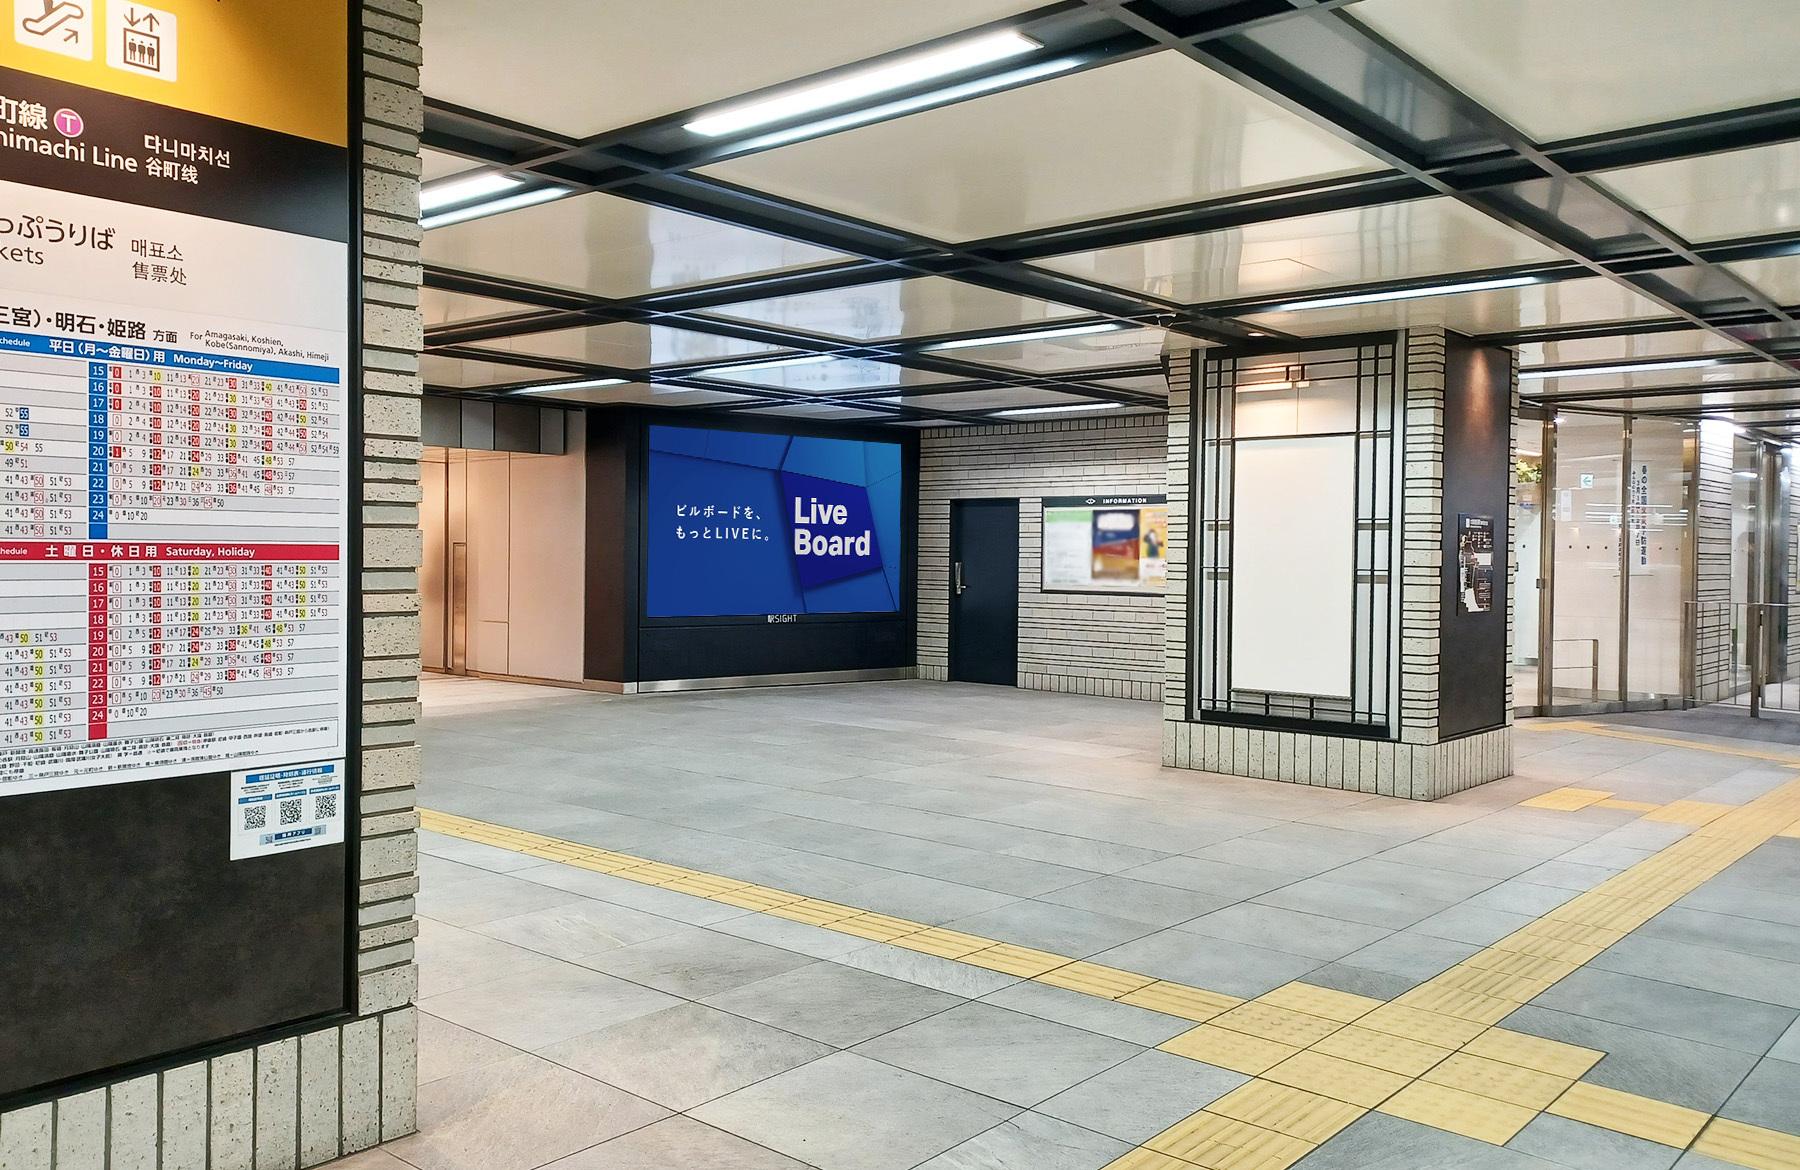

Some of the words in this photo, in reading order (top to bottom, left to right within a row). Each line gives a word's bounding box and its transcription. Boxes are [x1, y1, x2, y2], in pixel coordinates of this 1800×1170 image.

[60, 113, 76, 132] T
[144, 134, 231, 169] 다니마치선
[93, 146, 138, 172] Line
[145, 157, 199, 184] 谷町线
[131, 239, 184, 262] 매표소
[132, 261, 187, 286] 售票处
[153, 330, 178, 344] 方面
[190, 332, 202, 340] For
[204, 330, 250, 344] Amagasaki,
[252, 335, 284, 347] Koshien,
[205, 339, 277, 356] Kobe(Sannomiya),
[278, 348, 305, 358] Akashi,
[306, 352, 330, 362] Himeji
[93, 366, 104, 375] 15
[93, 382, 104, 391] 16
[93, 398, 104, 408] 17
[5, 408, 13, 417] 52
[20, 409, 28, 418] 55
[93, 415, 104, 424] 18
[5, 424, 13, 434] 52
[20, 426, 28, 435] 55
[93, 431, 104, 440] 19
[5, 441, 14, 451] 50
[20, 442, 28, 452] 54
[35, 443, 43, 452] 55
[92, 446, 104, 455] 20
[5, 458, 13, 468] 49
[20, 459, 28, 468] 51
[92, 462, 104, 472] 21
[5, 475, 13, 484] 41
[20, 476, 28, 485] 43
[35, 476, 43, 485] 50
[50, 477, 57, 486] 51
[64, 478, 72, 486] 53
[92, 478, 104, 488] 22
[5, 492, 13, 502] 41
[20, 492, 28, 502] 43
[35, 493, 43, 502] 50
[50, 493, 57, 502] 51
[64, 494, 72, 503] 53
[92, 495, 104, 504] 23
[5, 508, 13, 518] 41
[20, 509, 28, 518] 43
[35, 510, 43, 518] 50
[50, 510, 57, 519] 51
[64, 510, 72, 519] 53
[92, 510, 104, 520] 24
[676, 504, 761, 520] ビルボードを、
[794, 496, 848, 524] Live
[5, 525, 13, 535] 41
[20, 526, 28, 535] 43
[35, 526, 43, 535] 50
[50, 526, 57, 535] 51
[64, 526, 72, 535] 53
[676, 526, 770, 542] もっとLIVEに。
[794, 528, 871, 556] Board
[166, 546, 214, 558] Saturday,
[218, 546, 255, 558] Holiday
[93, 567, 104, 576] 15
[93, 583, 104, 592] 16
[93, 599, 104, 608] 17
[93, 615, 104, 624] 18
[5, 634, 13, 643] 43
[20, 633, 28, 643] 50
[35, 633, 42, 642] 51
[50, 633, 57, 642] 53
[93, 631, 104, 640] 19
[5, 651, 12, 660] 41
[20, 650, 28, 659] 43
[35, 650, 43, 659] 50
[49, 649, 57, 658] 51
[64, 648, 71, 657] 53
[92, 647, 104, 656] 20
[5, 668, 12, 677] 41
[20, 667, 28, 676] 43
[35, 666, 43, 675] 50
[49, 665, 57, 674] 51
[64, 665, 71, 674] 53
[92, 663, 104, 672] 21
[5, 685, 12, 694] 41
[20, 683, 28, 693] 43
[35, 682, 43, 692] 50
[49, 682, 57, 691] 51
[64, 681, 71, 690] 53
[92, 679, 104, 688] 22
[5, 701, 12, 710] 41
[20, 700, 28, 709] 43
[35, 699, 43, 708] 50
[49, 698, 57, 707] 51
[64, 697, 71, 706] 53
[92, 695, 104, 704] 23
[5, 718, 12, 727] 41
[20, 716, 28, 726] 43
[35, 715, 43, 724] 50
[49, 714, 57, 724] 51
[64, 713, 71, 722] 53
[92, 711, 104, 720] 24
[5, 734, 12, 743] 41
[20, 733, 28, 742] 43
[35, 732, 43, 741] 50
[49, 731, 57, 740] 51
[64, 730, 71, 738] 53
